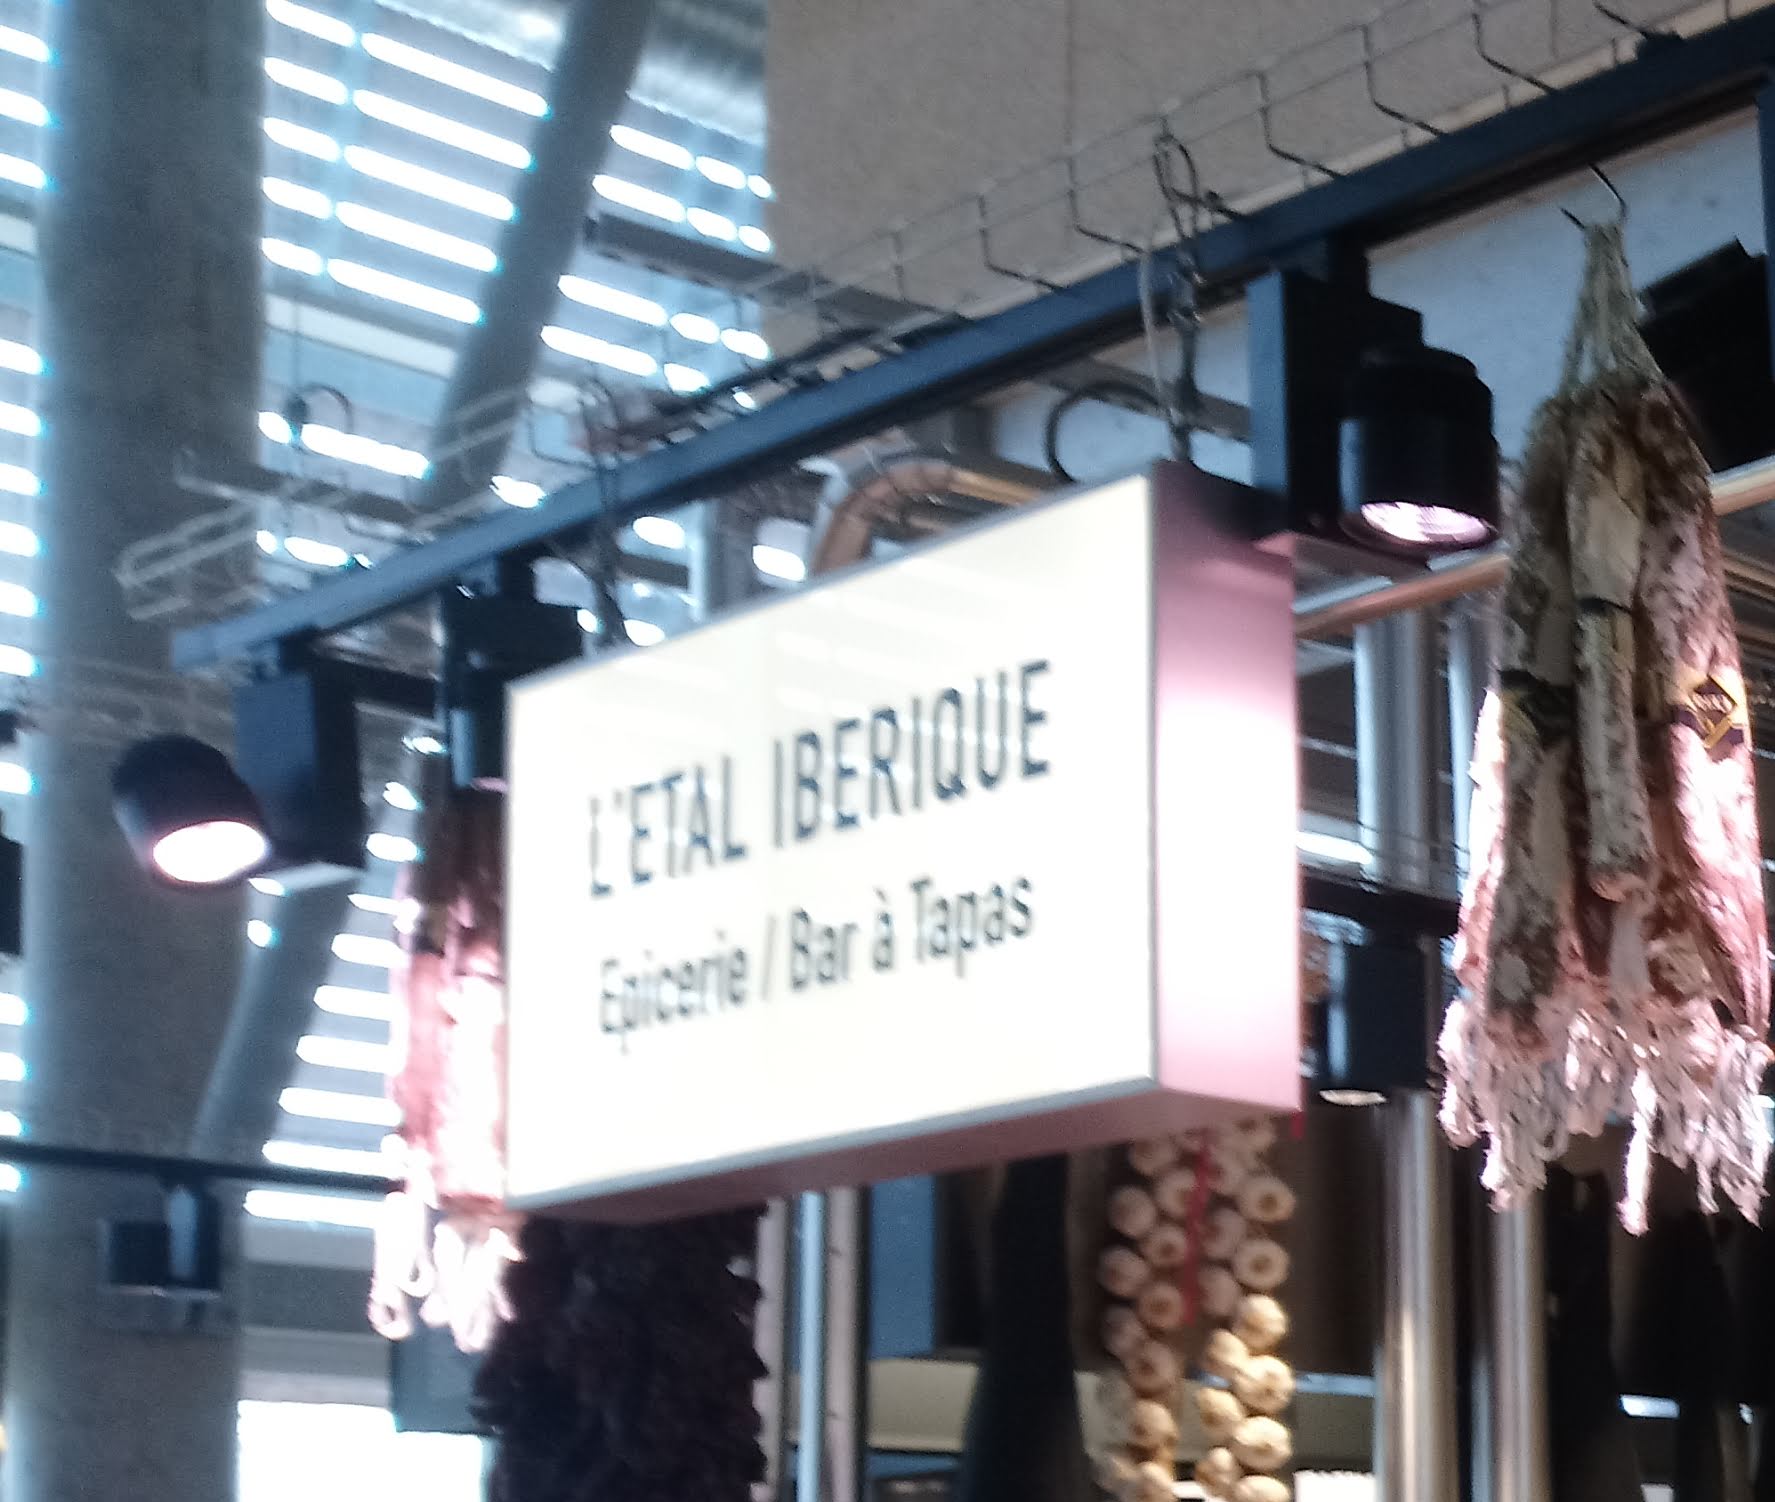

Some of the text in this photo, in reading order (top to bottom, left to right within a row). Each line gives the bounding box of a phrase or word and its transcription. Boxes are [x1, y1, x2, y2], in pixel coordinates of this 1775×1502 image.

[590, 659, 1050, 898] L'ETAL IBERIQUE
[599, 929, 747, 1055] Epicerie
[790, 906, 858, 993] Bar
[873, 887, 894, 971] à
[909, 876, 1033, 979] Tapas
